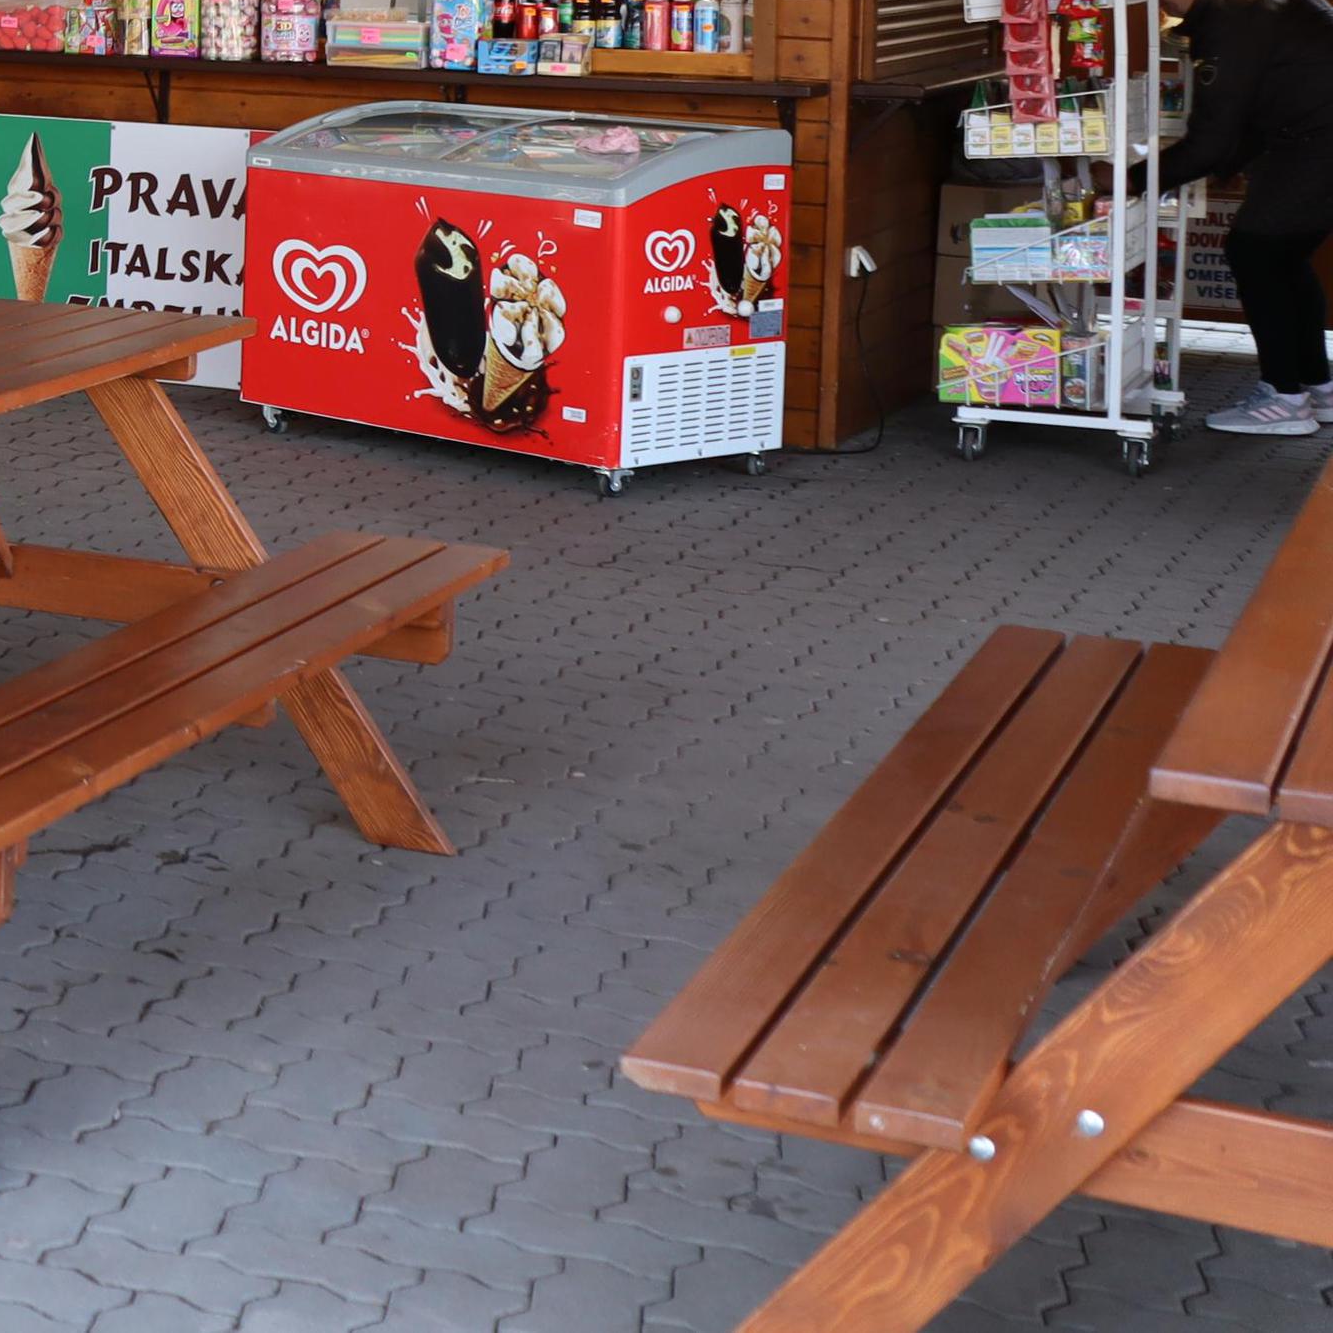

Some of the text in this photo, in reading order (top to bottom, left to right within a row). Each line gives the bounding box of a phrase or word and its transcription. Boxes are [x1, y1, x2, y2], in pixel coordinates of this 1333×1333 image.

[88, 238, 245, 286] ITALSK
[643, 274, 694, 294] ALGIDA
[269, 314, 365, 355] ALGIDA
